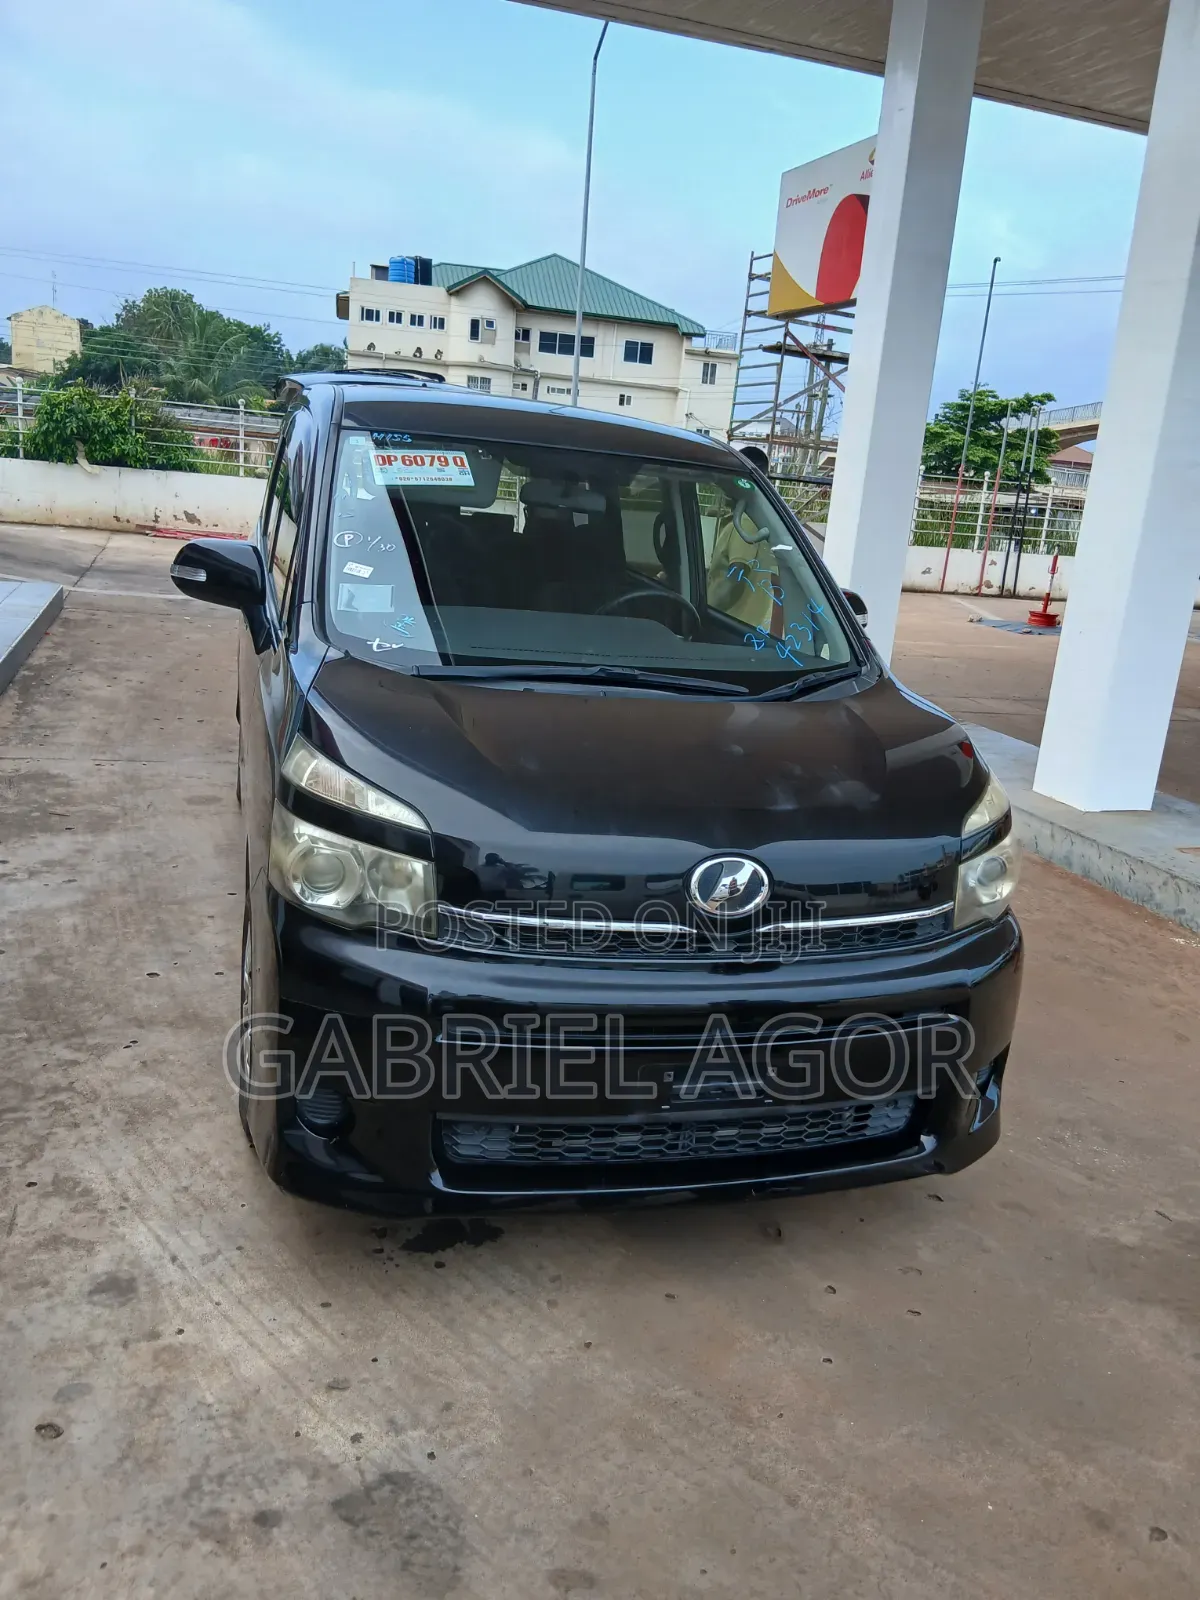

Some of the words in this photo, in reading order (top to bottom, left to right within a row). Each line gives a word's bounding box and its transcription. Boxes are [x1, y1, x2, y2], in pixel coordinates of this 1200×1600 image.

[785, 186, 830, 208] DriveMore
[374, 454, 399, 467] DP
[401, 454, 450, 468] 6079
[453, 455, 468, 469] Q
